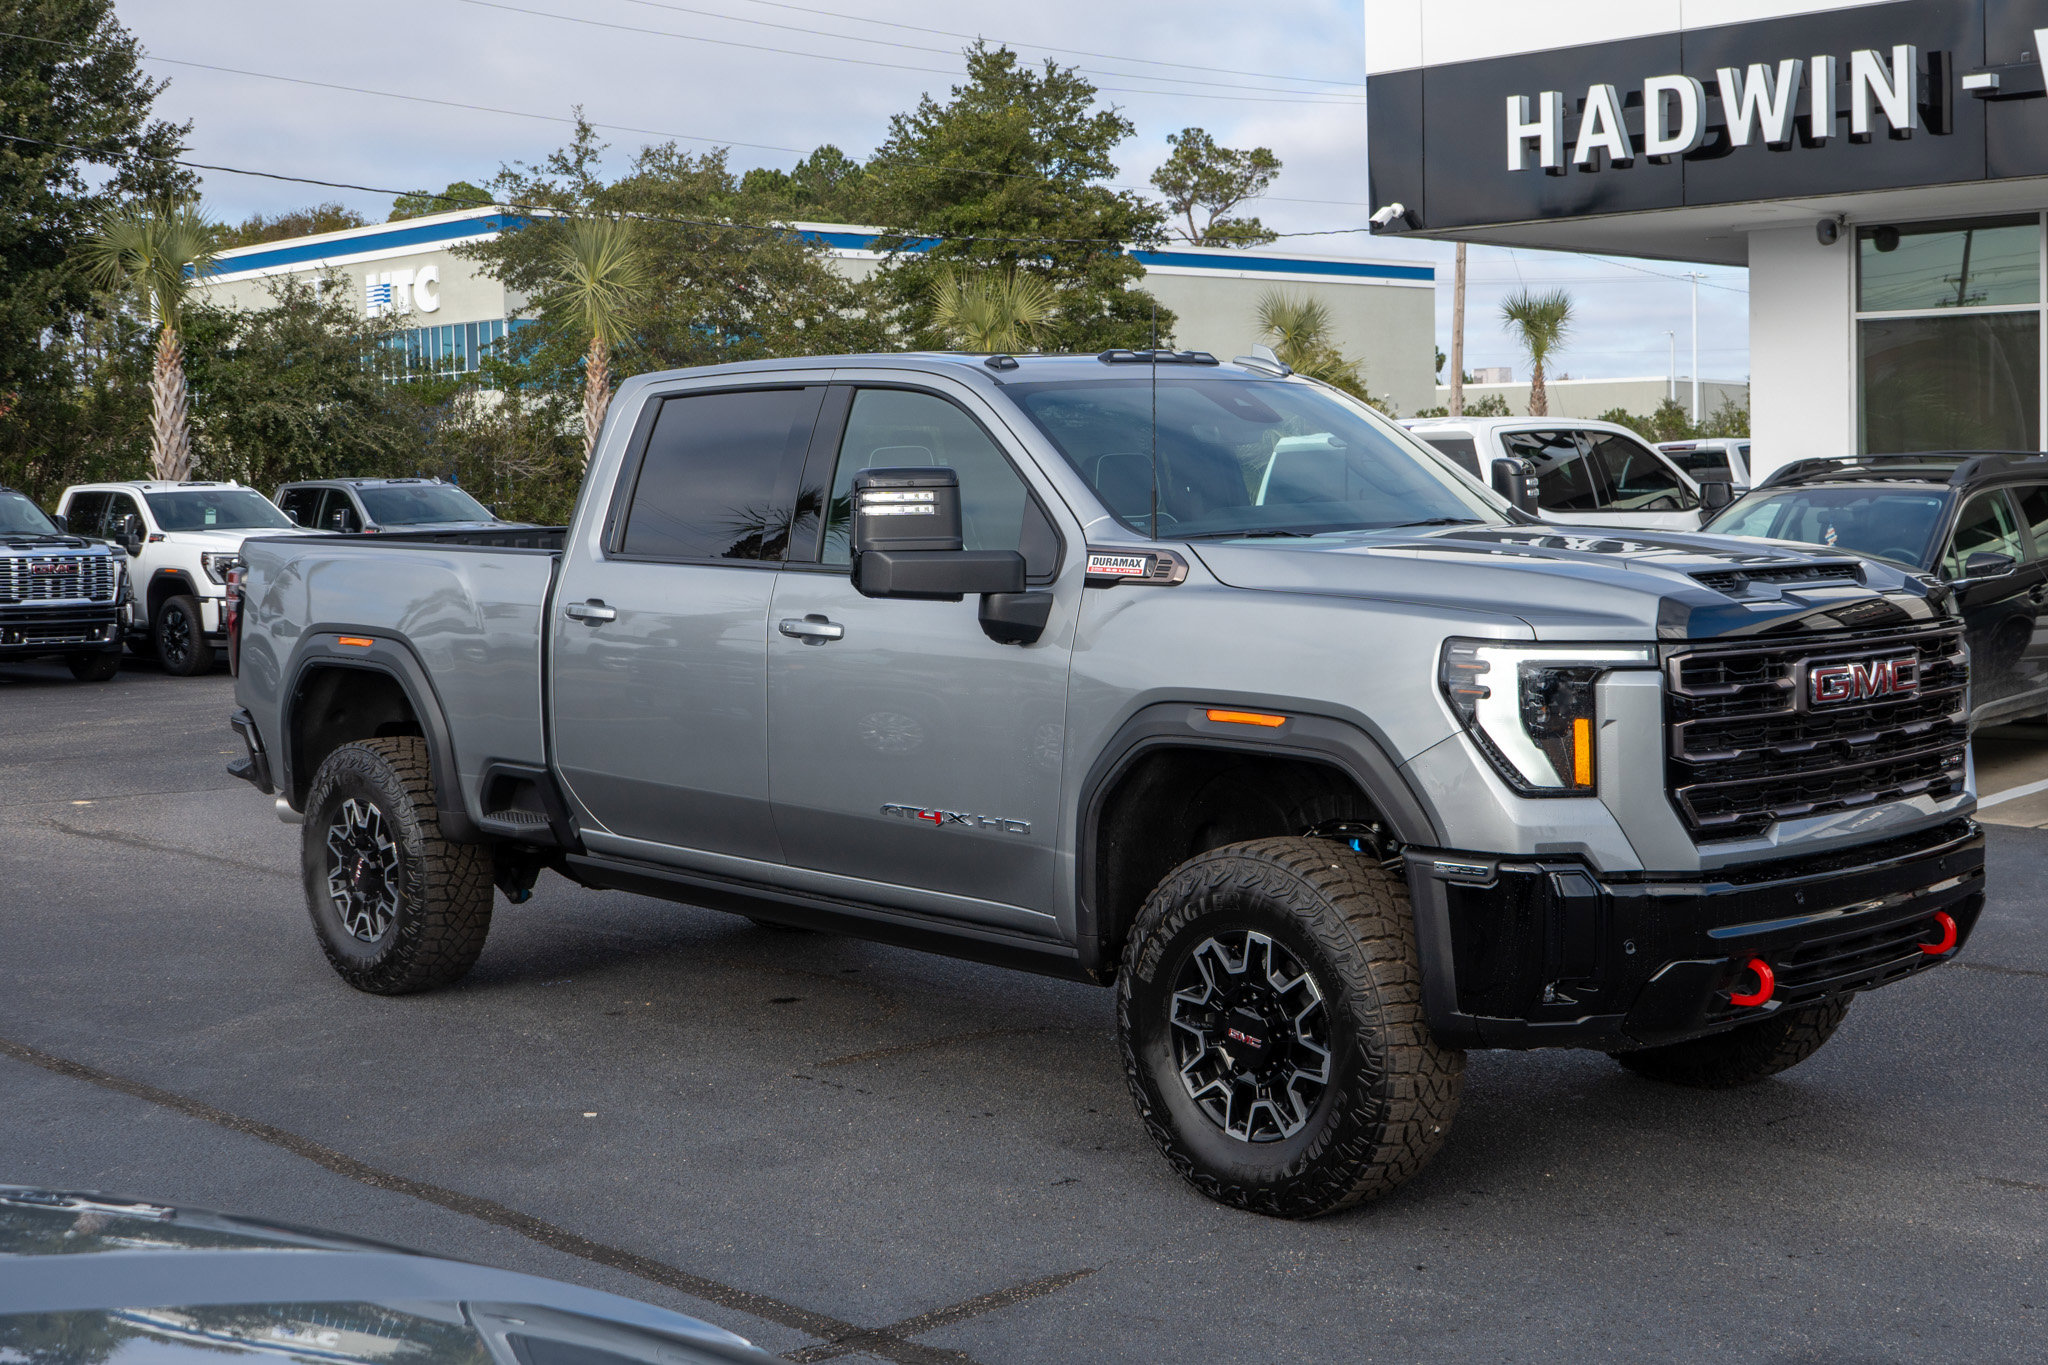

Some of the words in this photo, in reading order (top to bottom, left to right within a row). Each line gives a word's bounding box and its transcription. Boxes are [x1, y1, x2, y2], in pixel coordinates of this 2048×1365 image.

[1507, 44, 1917, 171] HADWIN
[366, 265, 440, 318] HTC
[1092, 557, 1142, 568] DURAMAX
[1810, 658, 1917, 704] GMC
[880, 803, 973, 827] AT4X
[1136, 891, 1240, 984] WRANGLER
[1228, 1027, 1262, 1049] GMC
